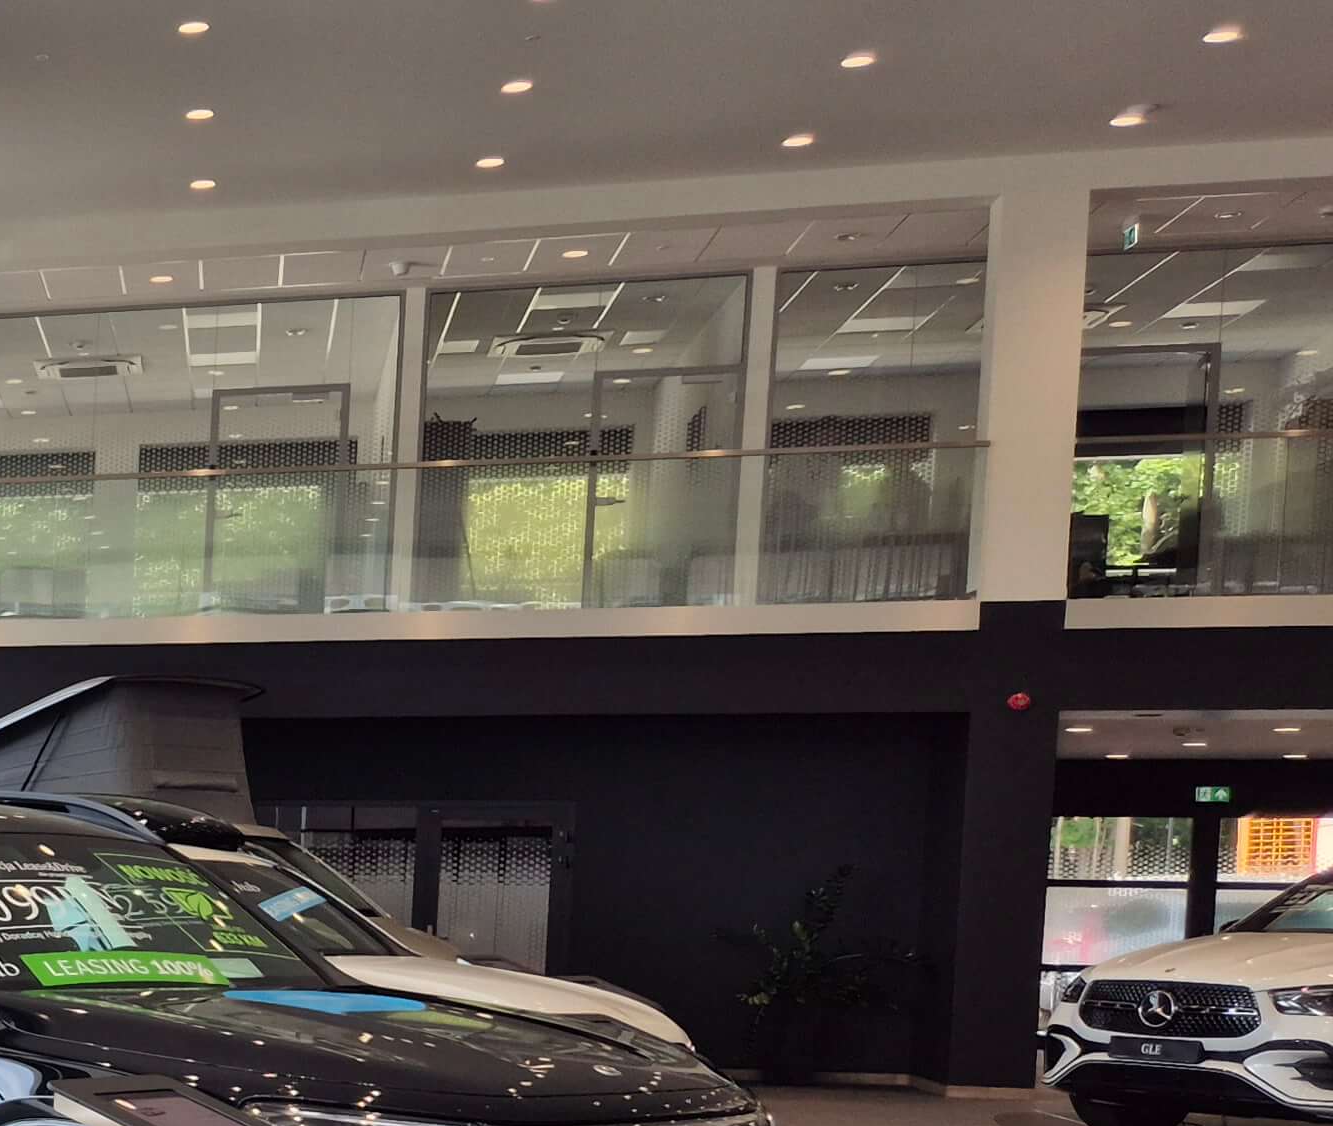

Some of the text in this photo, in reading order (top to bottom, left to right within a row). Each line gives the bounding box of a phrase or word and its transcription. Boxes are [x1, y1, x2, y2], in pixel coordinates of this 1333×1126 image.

[43, 957, 214, 978] LEASING 100%
[1140, 1042, 1163, 1055] GLE
